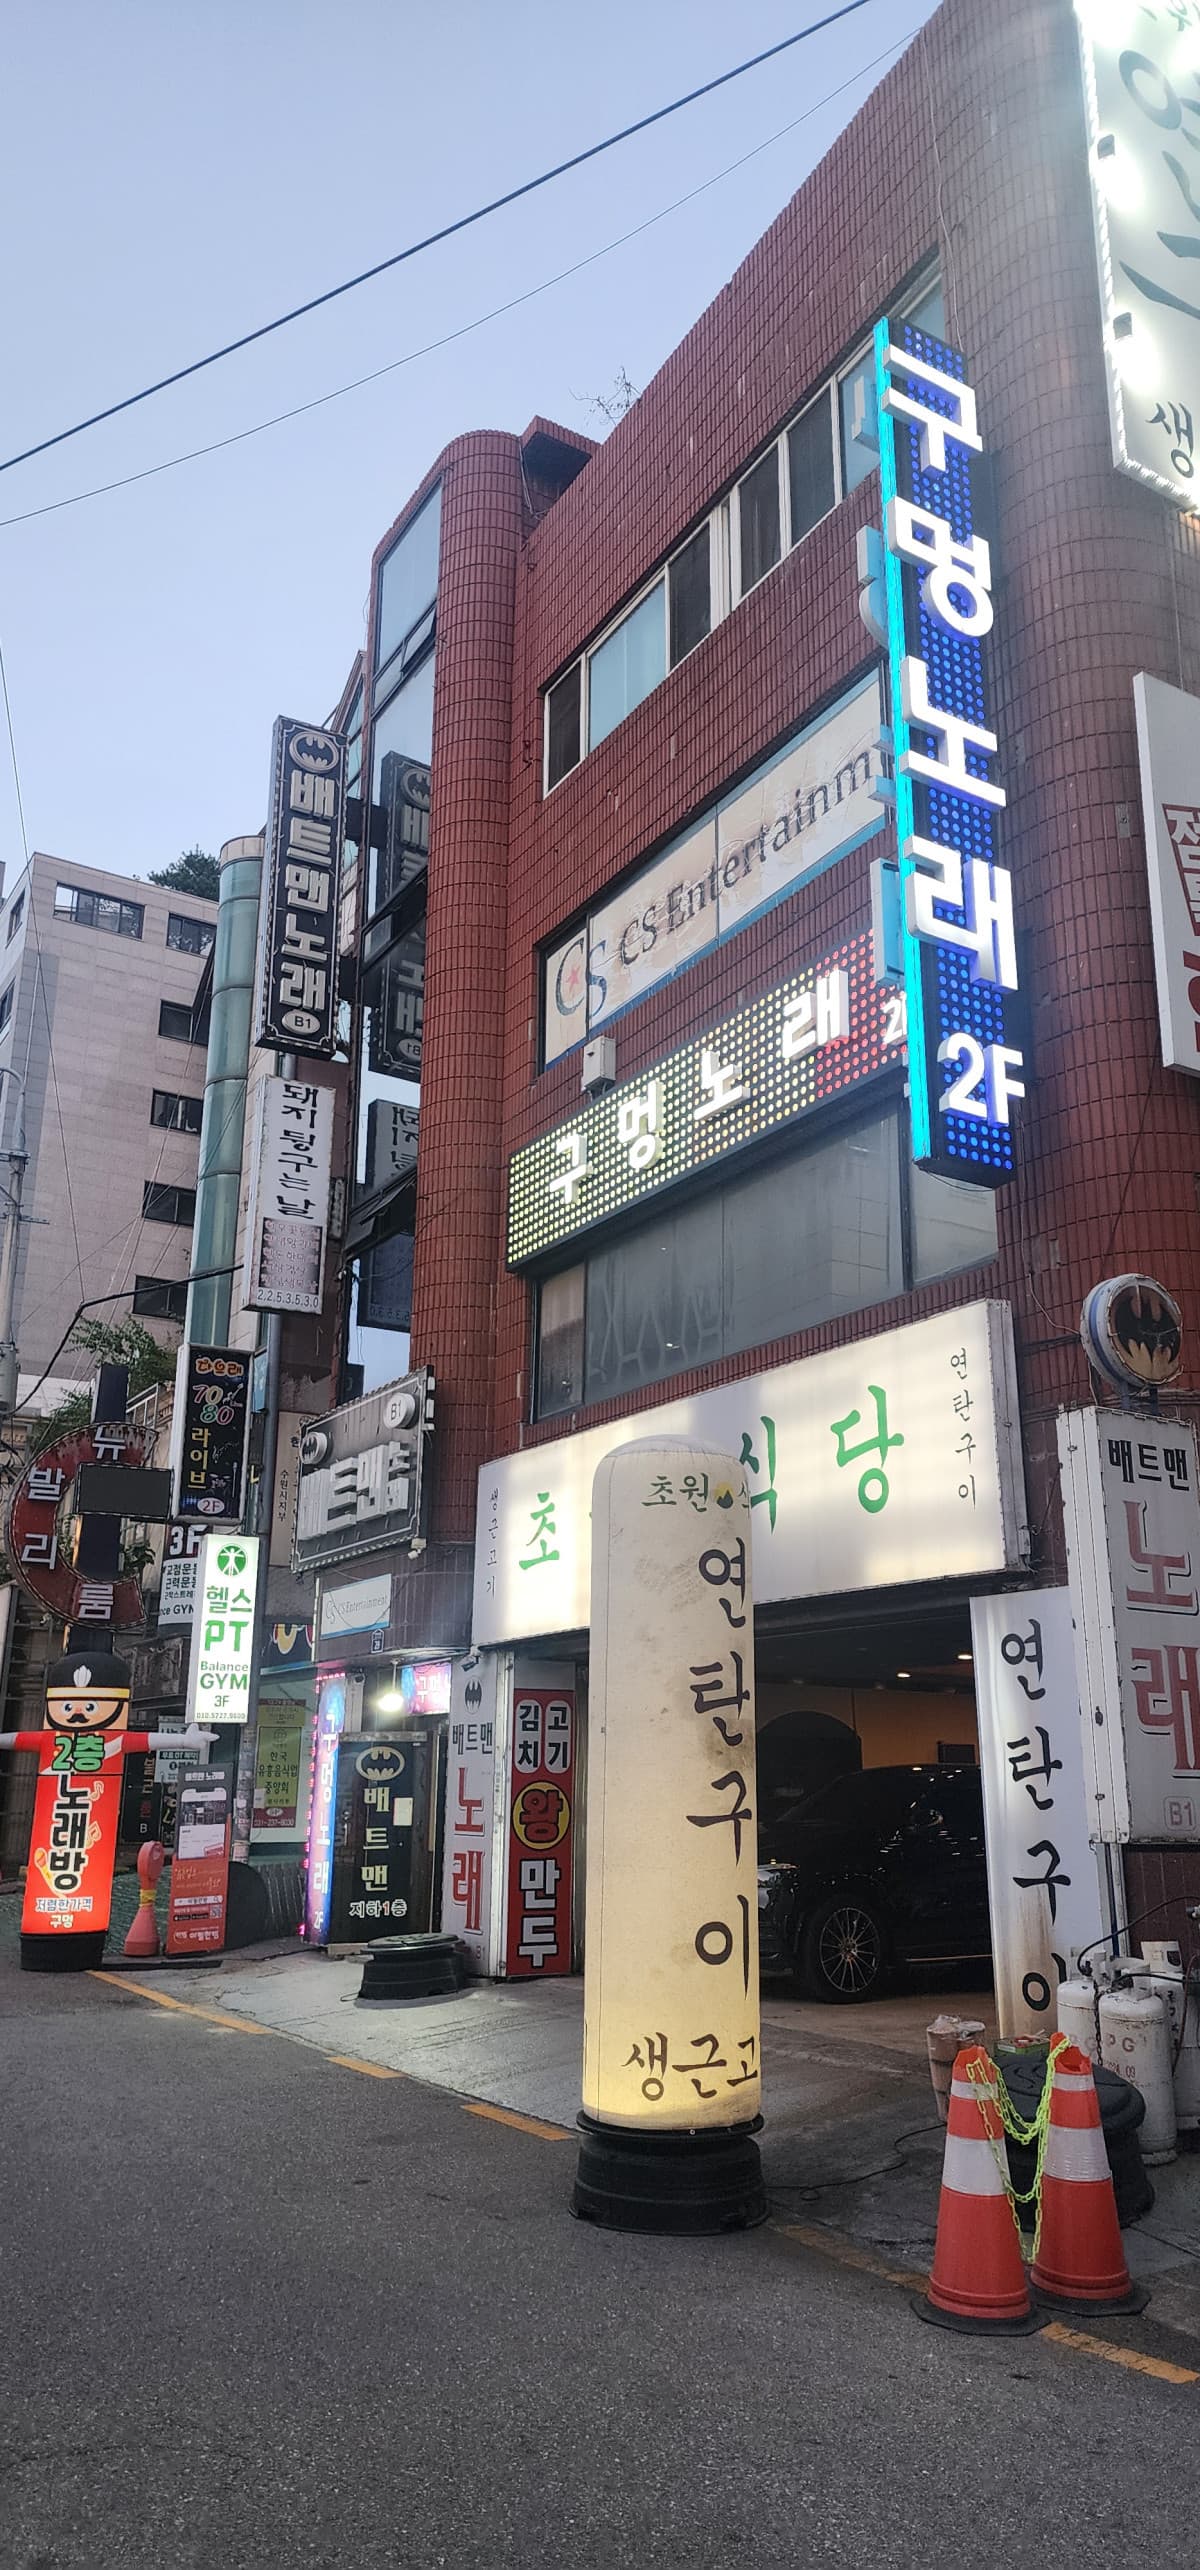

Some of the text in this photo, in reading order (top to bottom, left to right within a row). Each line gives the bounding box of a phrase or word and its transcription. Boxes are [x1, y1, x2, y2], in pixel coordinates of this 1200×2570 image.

[882, 344, 1019, 991] 구멍노래
[294, 1015, 312, 1030] B1
[548, 969, 849, 1205] 구멍노래
[937, 1031, 1026, 1128] 2F
[201, 1404, 234, 1425] 80
[949, 1346, 978, 1511] 연탄구이
[188, 1427, 212, 1489] 라이브
[518, 1384, 905, 1571] 초식당
[1107, 1439, 1190, 1492] 배트맨
[202, 1500, 221, 1512] 2F
[641, 1472, 709, 1513] 초원
[169, 1525, 207, 1555] 3F
[206, 1585, 253, 1614] 헬스
[204, 1619, 251, 1652] PT
[1122, 1500, 1200, 1770] 노래
[200, 1660, 249, 1672] Balance
[200, 1673, 248, 1691] GYM
[214, 1696, 230, 1708] 3F
[51, 1735, 105, 1772] 2층
[453, 1722, 493, 1755] 배트맨
[517, 1705, 541, 1769] 김치
[547, 1706, 569, 1769] 고기
[685, 1536, 753, 2000] 연탄구이
[49, 1773, 91, 1892] 노래방
[361, 1786, 391, 1891] 배트맨
[1000, 1618, 1072, 2012] 연탄구이
[1169, 1800, 1194, 1829] B1
[452, 1768, 486, 1931] 노래
[348, 1898, 409, 1918] 지하1층
